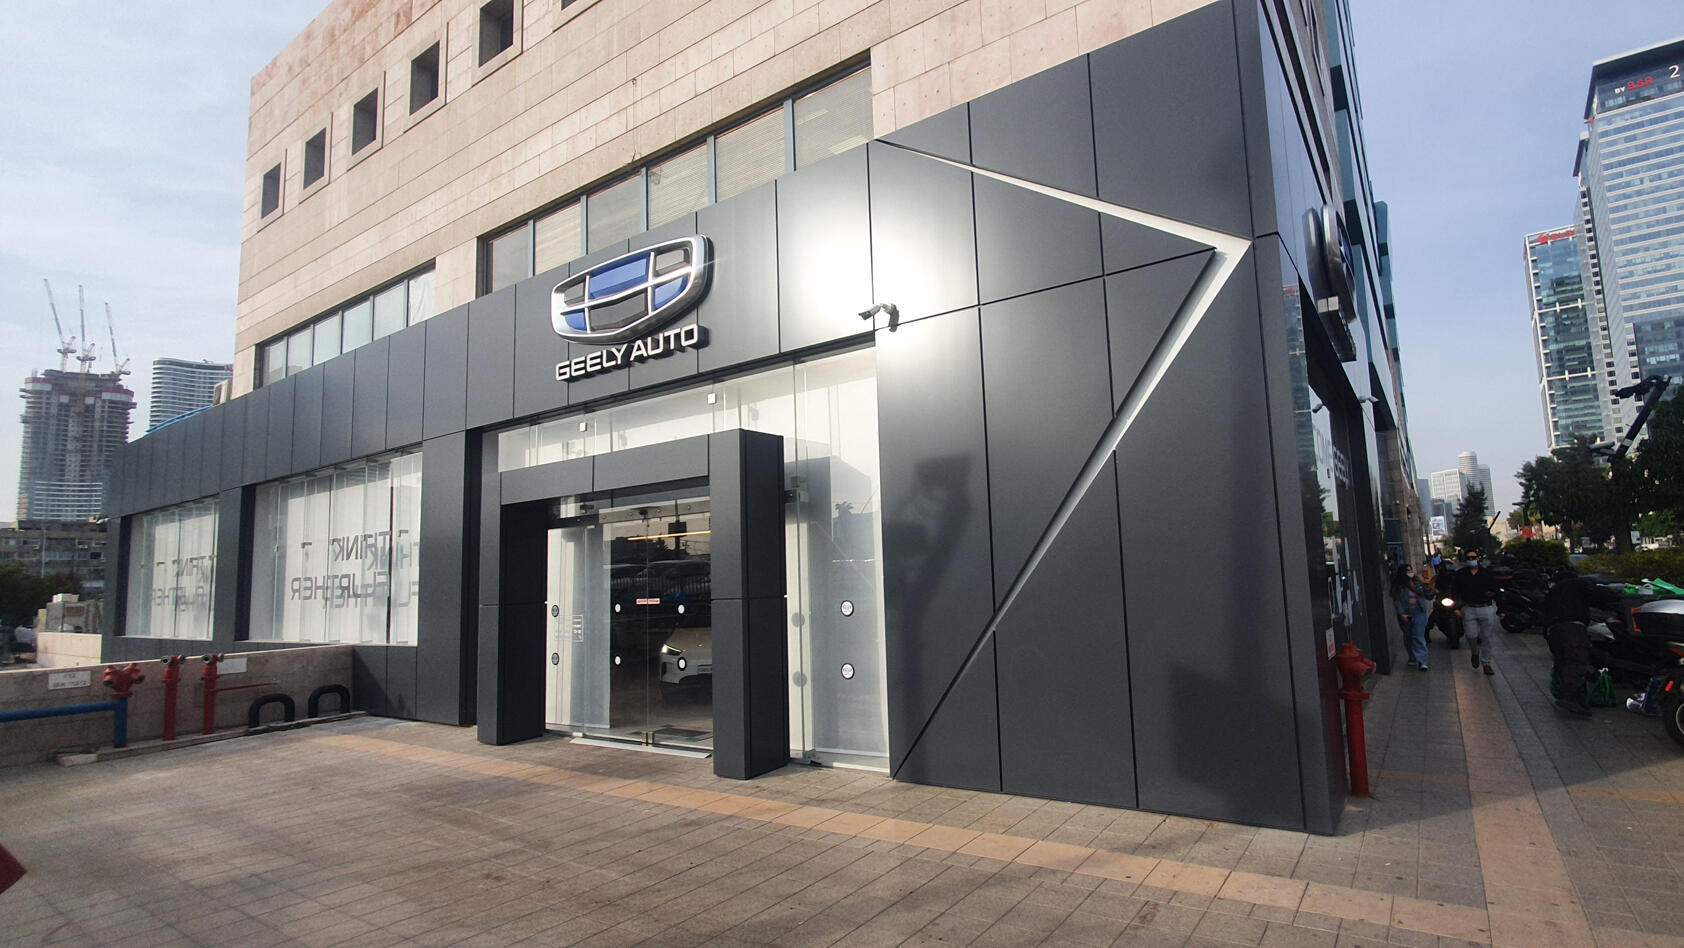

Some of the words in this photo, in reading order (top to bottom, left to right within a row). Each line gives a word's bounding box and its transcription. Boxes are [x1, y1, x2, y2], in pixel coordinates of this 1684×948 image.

[1668, 64, 1681, 79] 2
[555, 343, 628, 381] GEELY
[629, 323, 698, 361] AUTO
